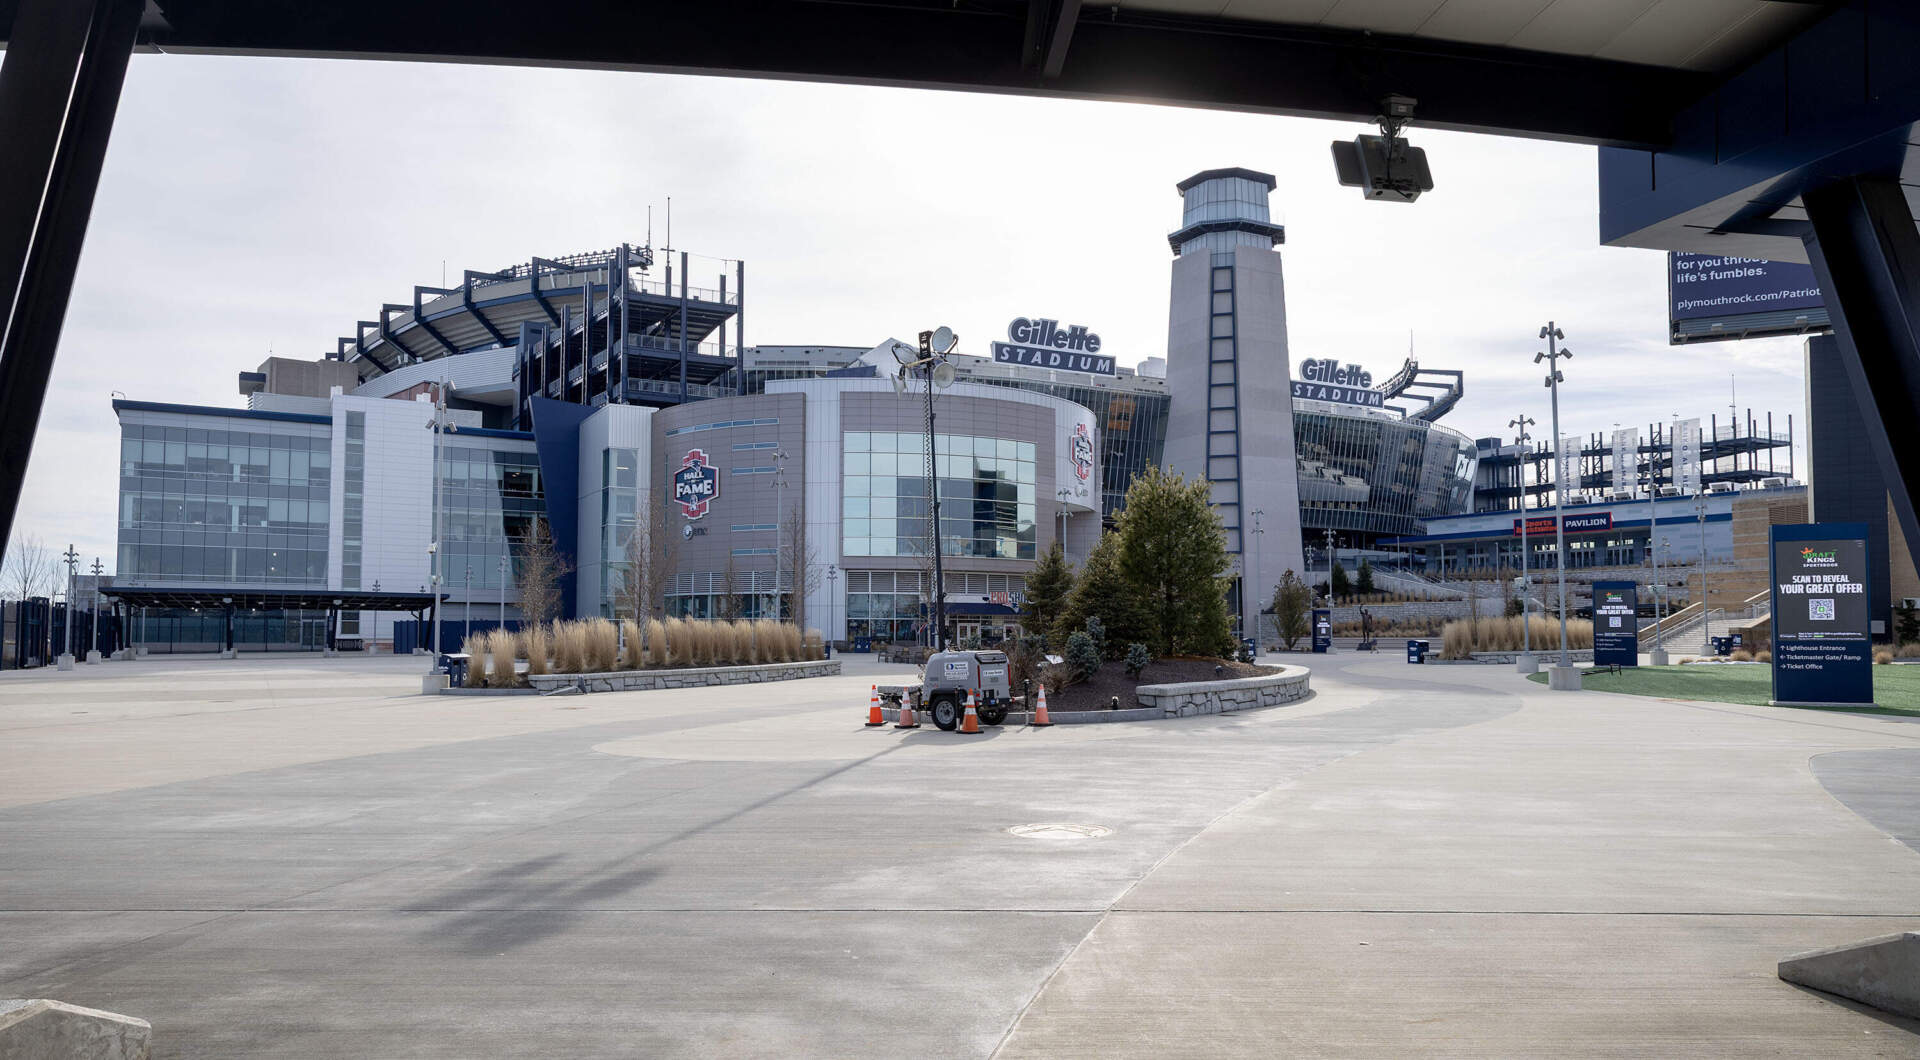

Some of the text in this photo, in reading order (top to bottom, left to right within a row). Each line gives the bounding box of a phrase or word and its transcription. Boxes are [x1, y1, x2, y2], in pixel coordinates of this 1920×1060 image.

[1677, 260, 1695, 270] for
[1697, 258, 1721, 271] you
[1677, 267, 1767, 283] life's fumbles.
[1009, 317, 1101, 353] Gillette
[1000, 346, 1111, 373] STADIUM
[1300, 358, 1372, 388] Gillette
[1293, 383, 1380, 406] STADIUM
[684, 471, 704, 480] HALL
[676, 480, 713, 498] FAME
[1565, 518, 1606, 528] PAVILION
[1802, 551, 1836, 559] DRAFT
[1792, 574, 1850, 583] SCAN TO REVEAL
[1780, 583, 1863, 594] YOUR GREAT OFFER
[1843, 654, 1861, 662] Ramp
